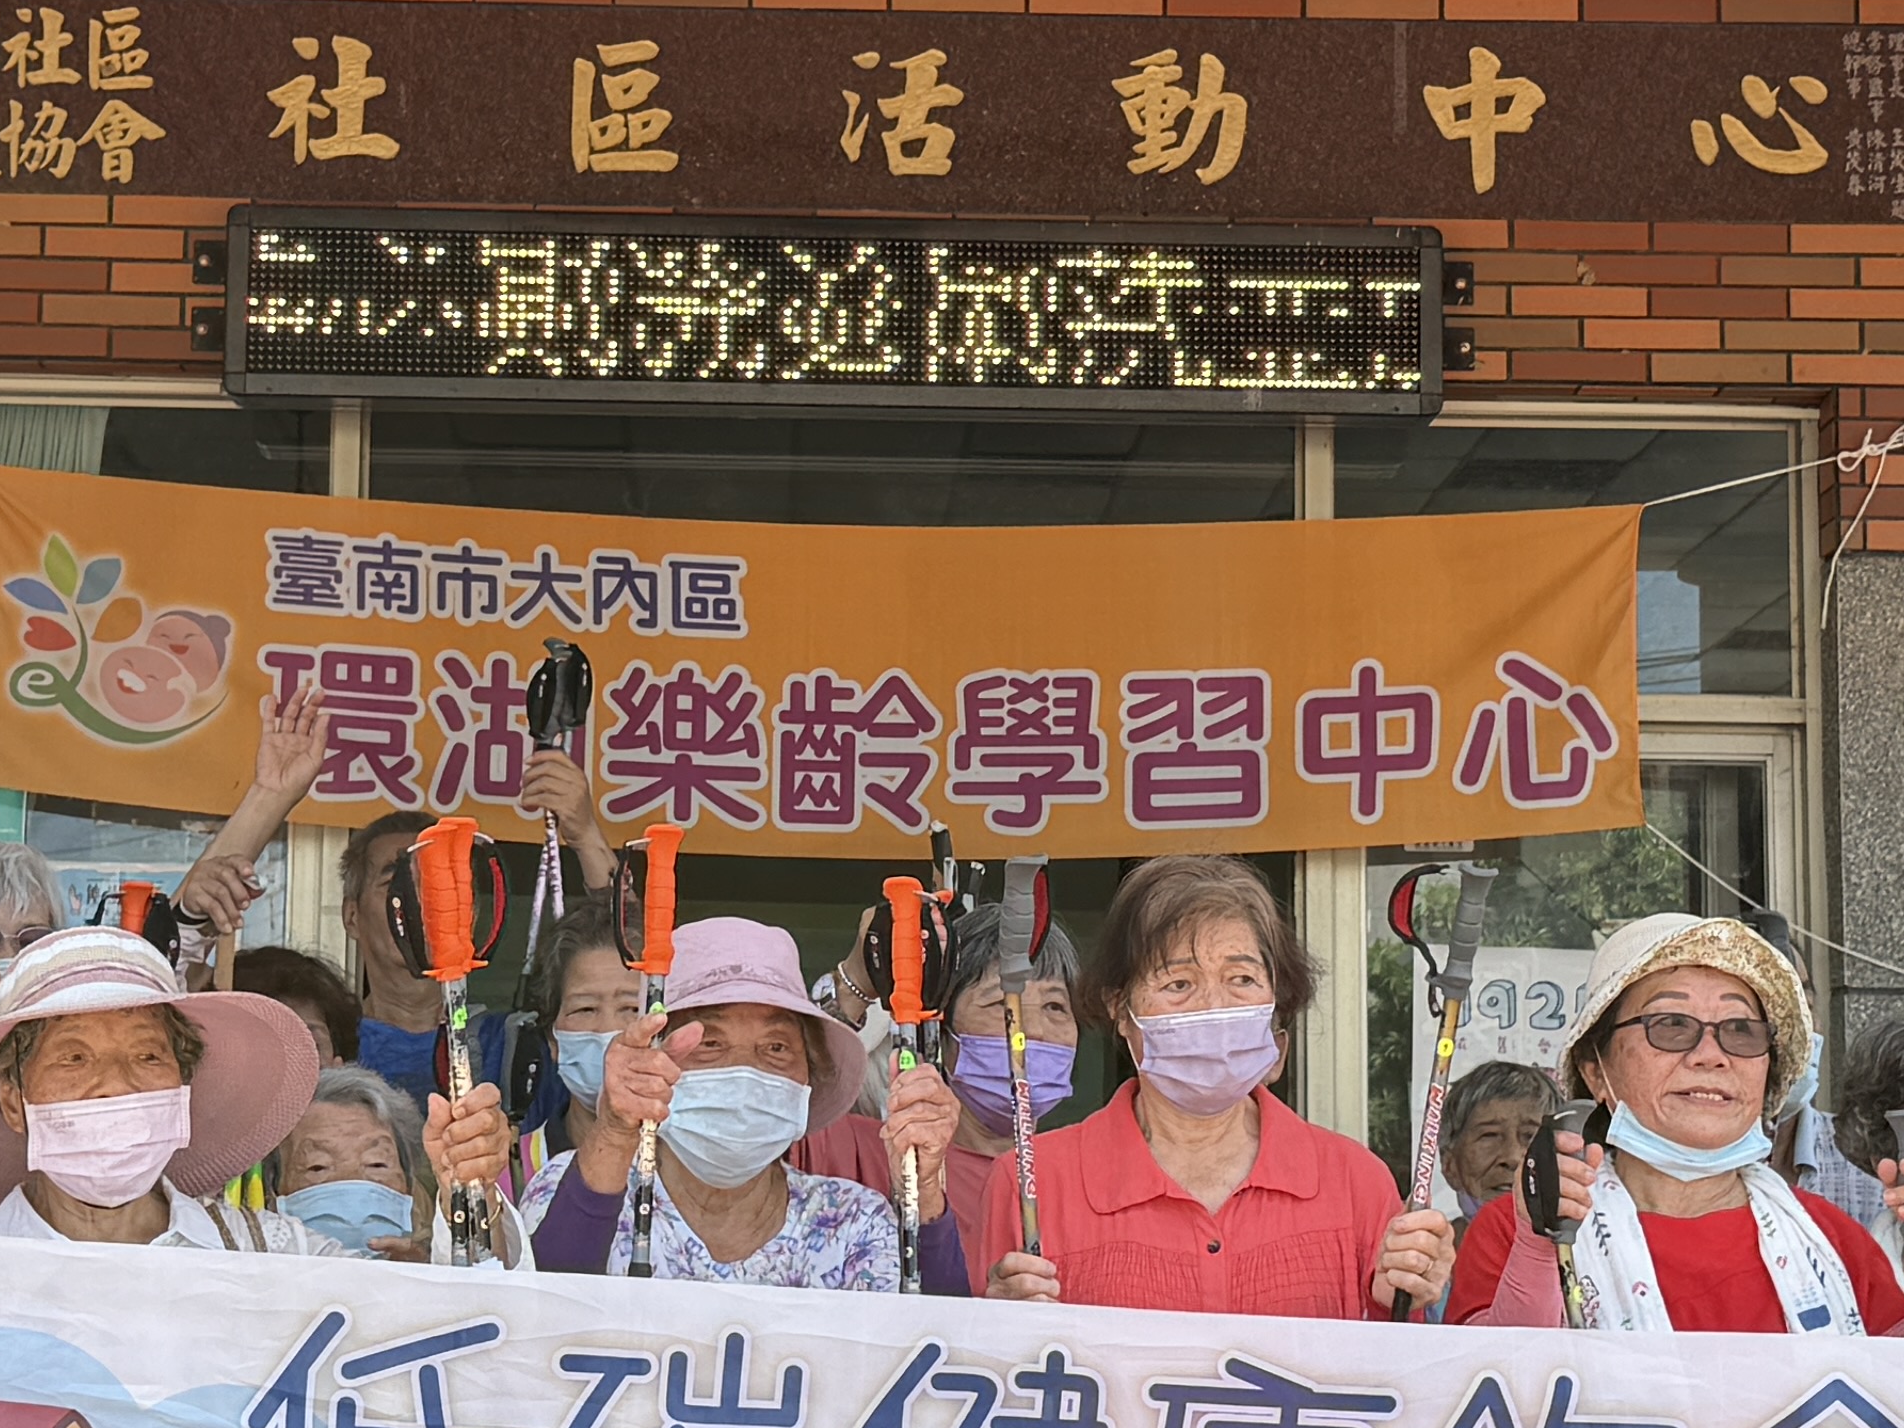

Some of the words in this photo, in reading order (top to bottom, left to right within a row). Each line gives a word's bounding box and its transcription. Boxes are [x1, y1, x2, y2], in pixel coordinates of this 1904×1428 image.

[267, 34, 1828, 194] 社區活動中心
[269, 531, 743, 633] 臺南市大內區
[265, 649, 1614, 830] 環湖樂齡學習中心
